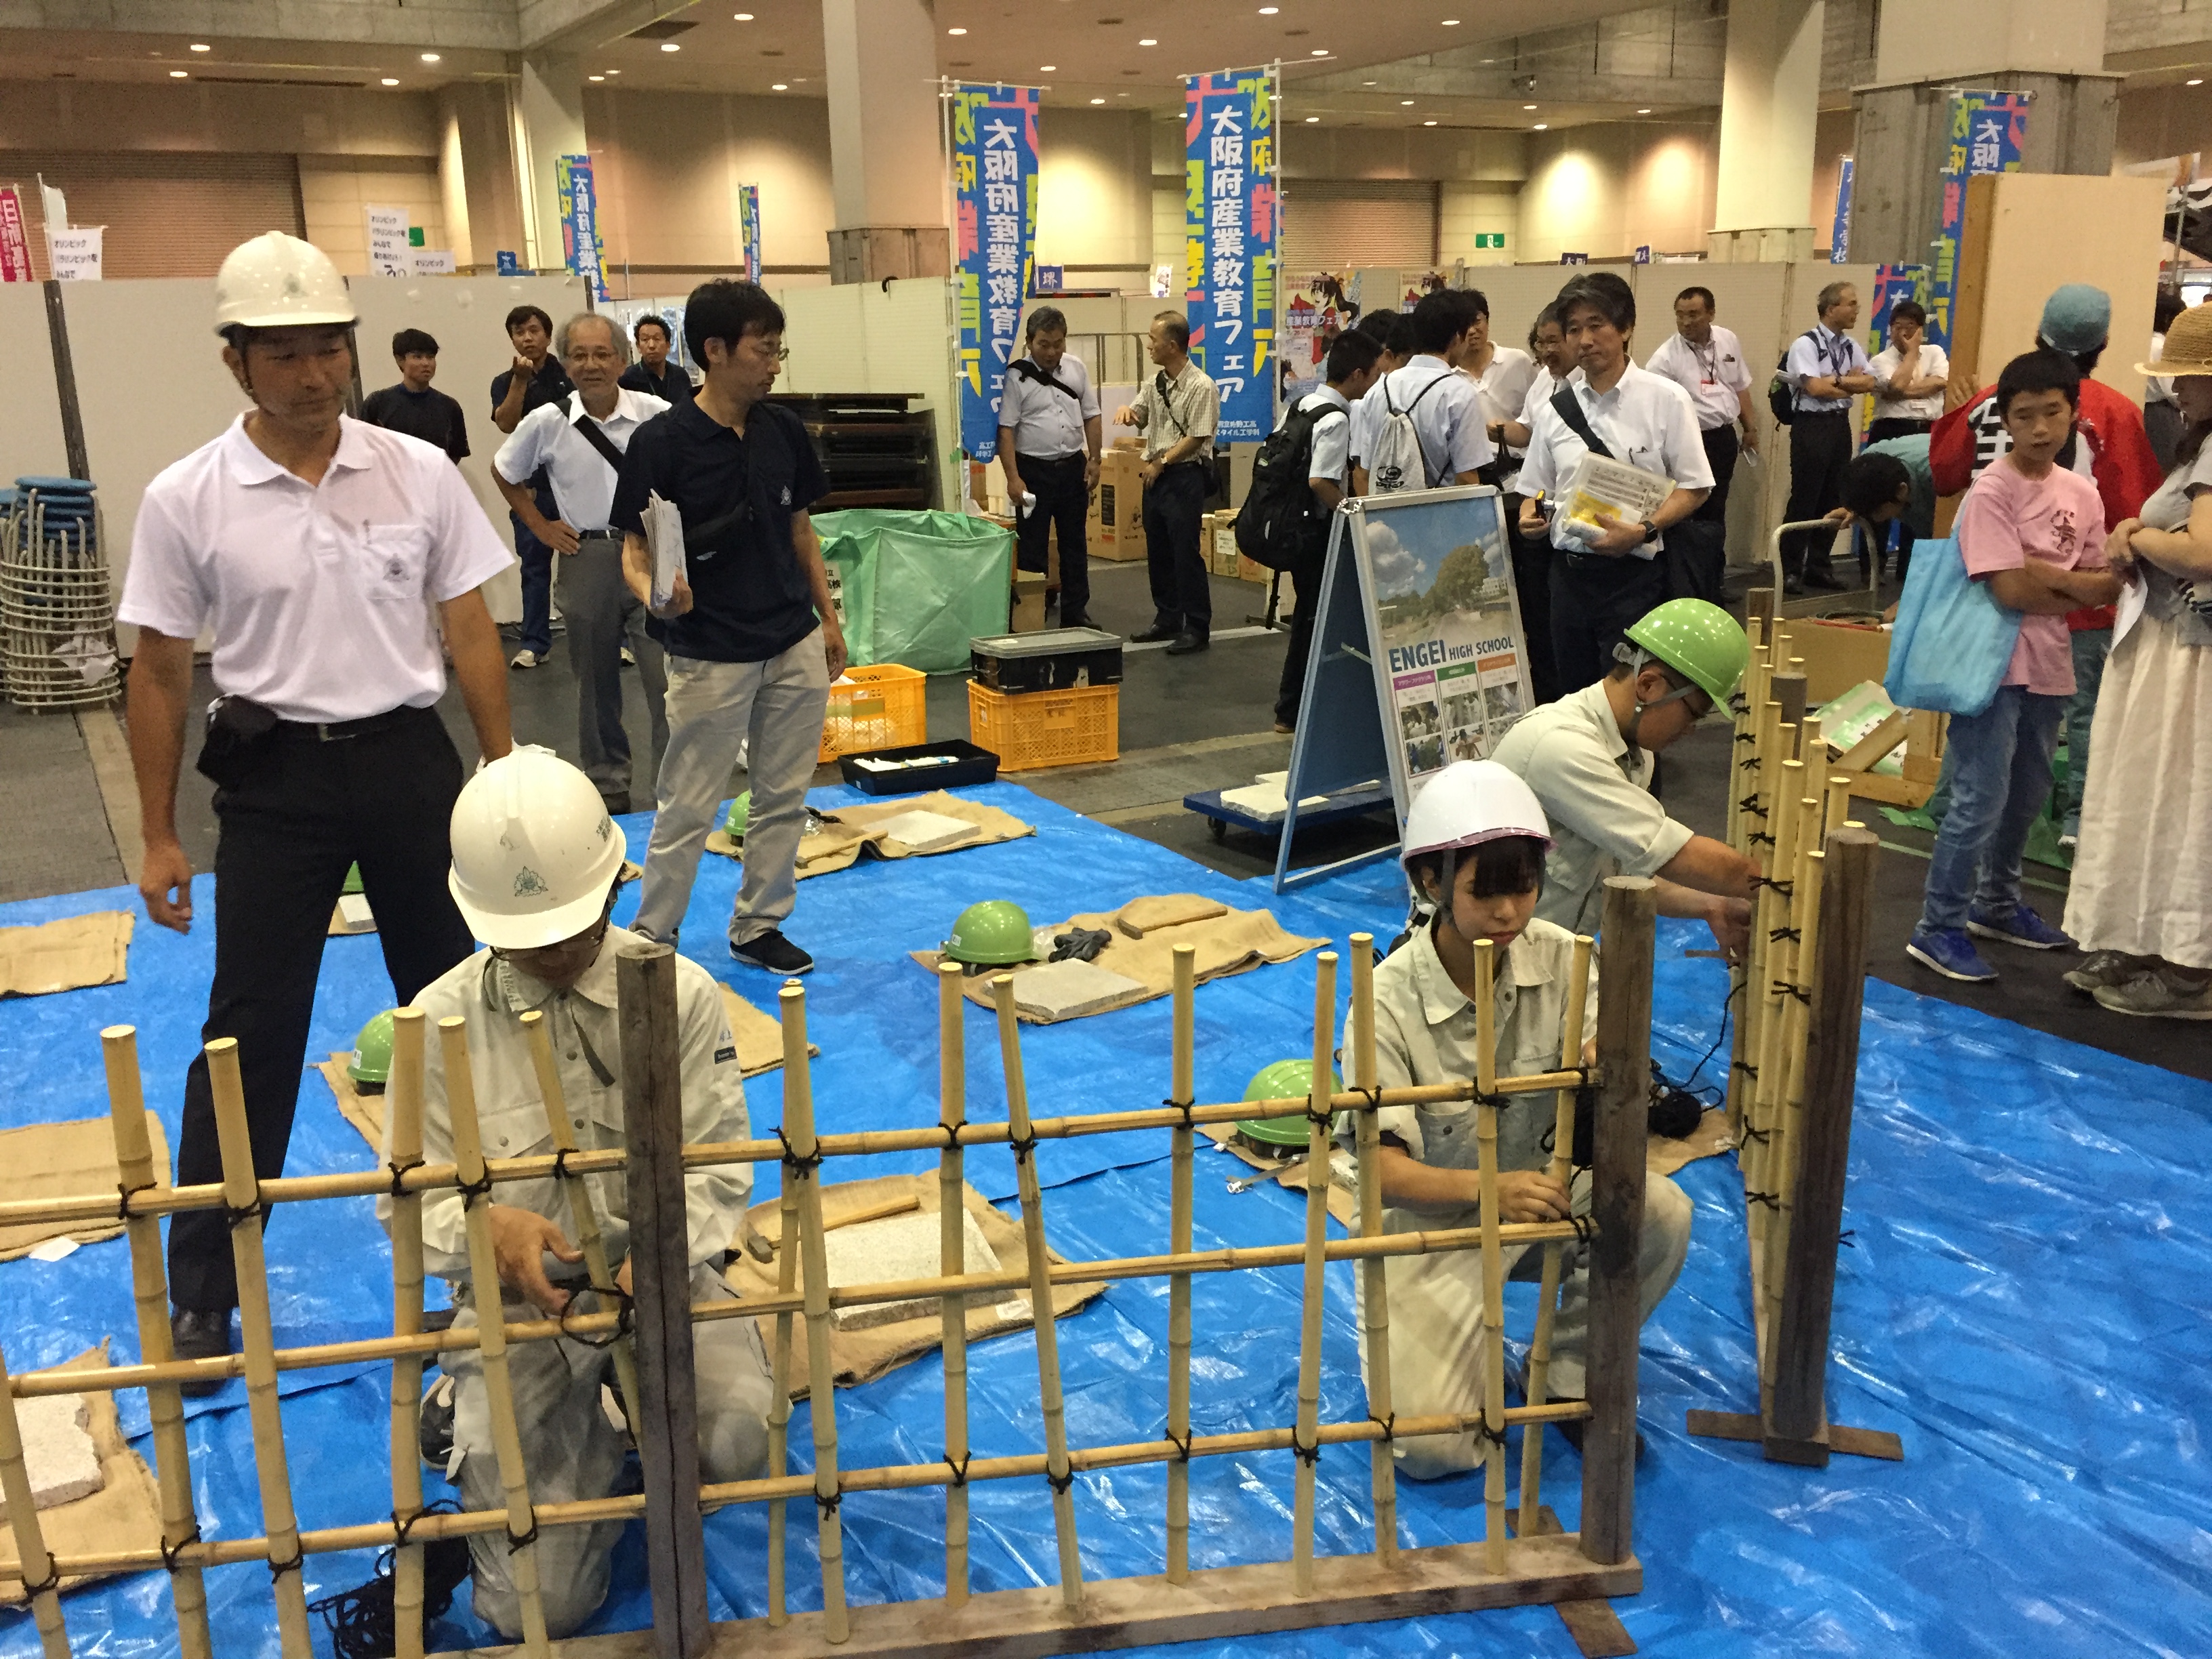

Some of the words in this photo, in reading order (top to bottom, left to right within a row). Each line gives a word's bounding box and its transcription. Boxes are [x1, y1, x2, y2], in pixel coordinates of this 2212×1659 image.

[1210, 105, 1244, 403] 大阪府産業教育フェア
[1389, 639, 1446, 673] ENGEI
[1449, 644, 1473, 661] HIGH
[1476, 636, 1514, 655] SCHOOL
